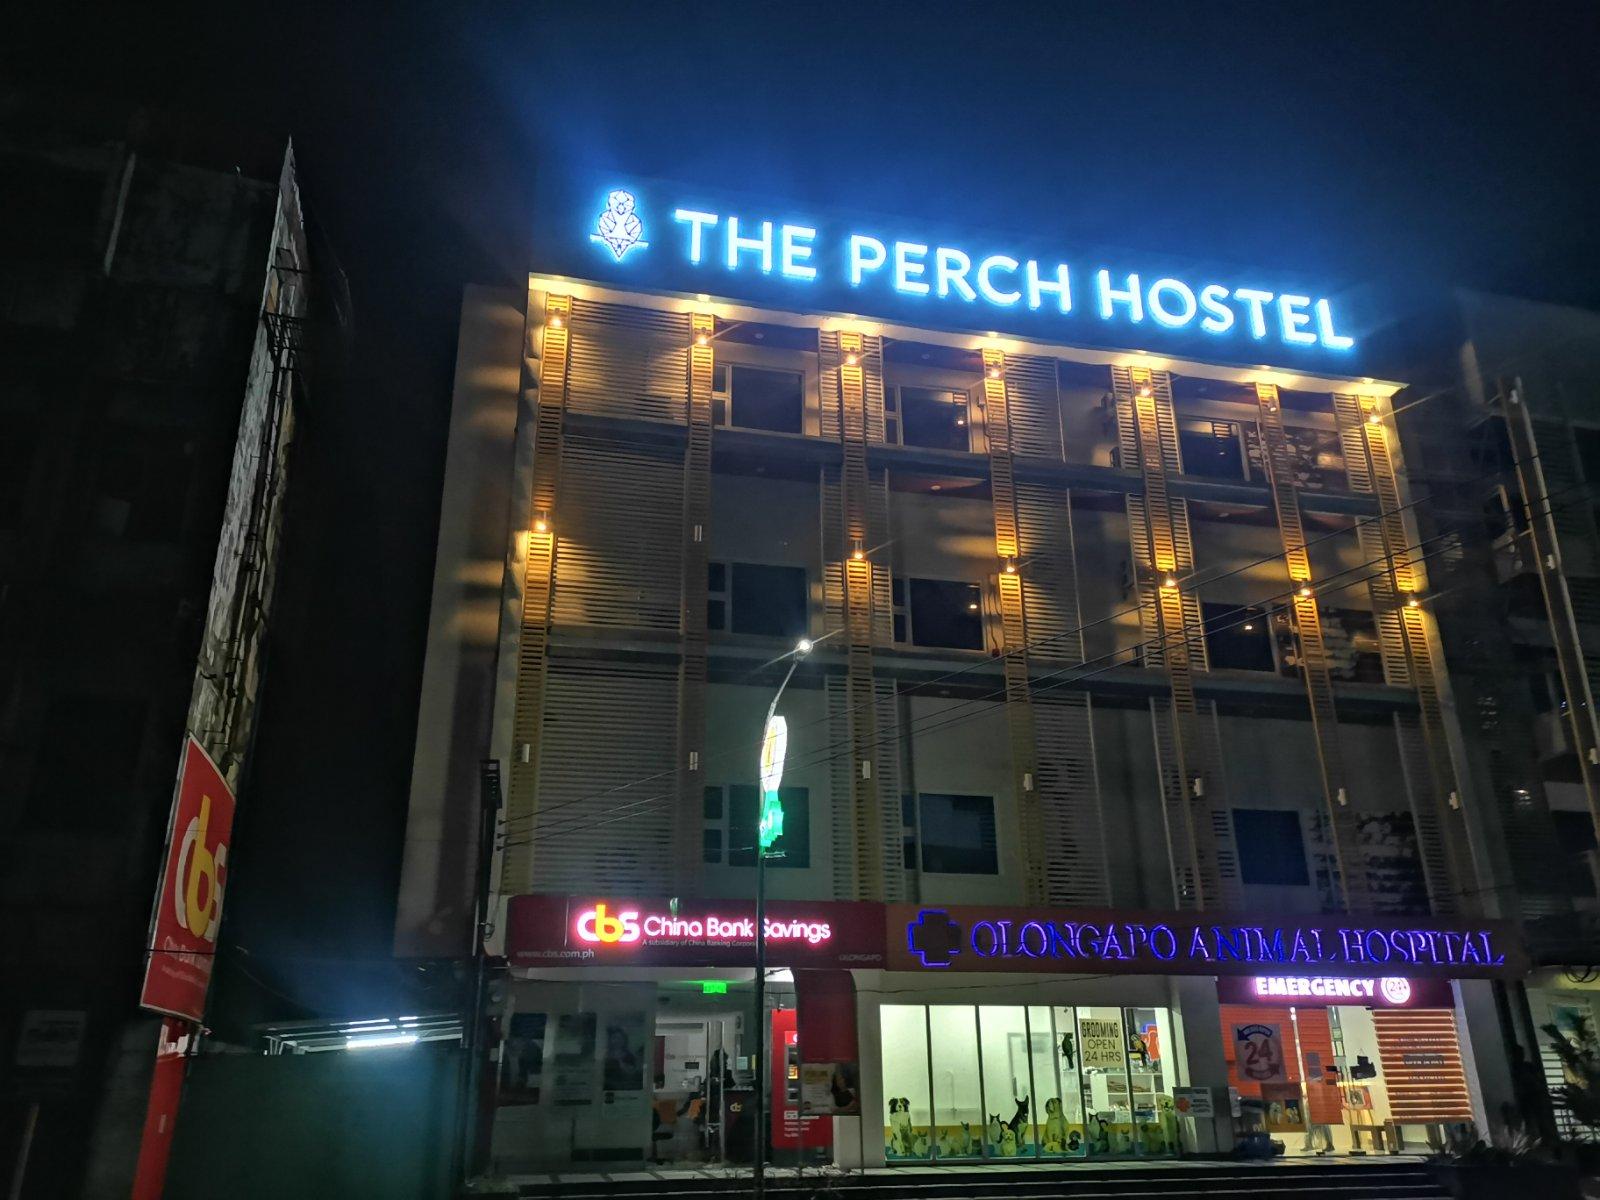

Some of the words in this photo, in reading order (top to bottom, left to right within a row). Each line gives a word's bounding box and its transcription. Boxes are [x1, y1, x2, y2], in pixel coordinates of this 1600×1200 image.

[674, 208, 816, 281] THE
[849, 234, 1072, 314] PERCH
[1097, 268, 1355, 350] HOSTEL
[643, 915, 702, 937] China
[706, 917, 754, 938] Bank
[516, 948, 595, 959] www.cbs.com.ph
[971, 920, 1176, 961] OLONGAPO
[1189, 926, 1336, 963] ANIMAL
[1339, 928, 1505, 966] HOSPITAL
[1255, 976, 1375, 997] EMERGENCY
[1081, 1021, 1119, 1038] GROOMING
[1087, 1039, 1116, 1050] OPEN
[1245, 1039, 1273, 1066] 24
[1084, 1051, 1098, 1062] 24
[1101, 1051, 1122, 1062] HRS
